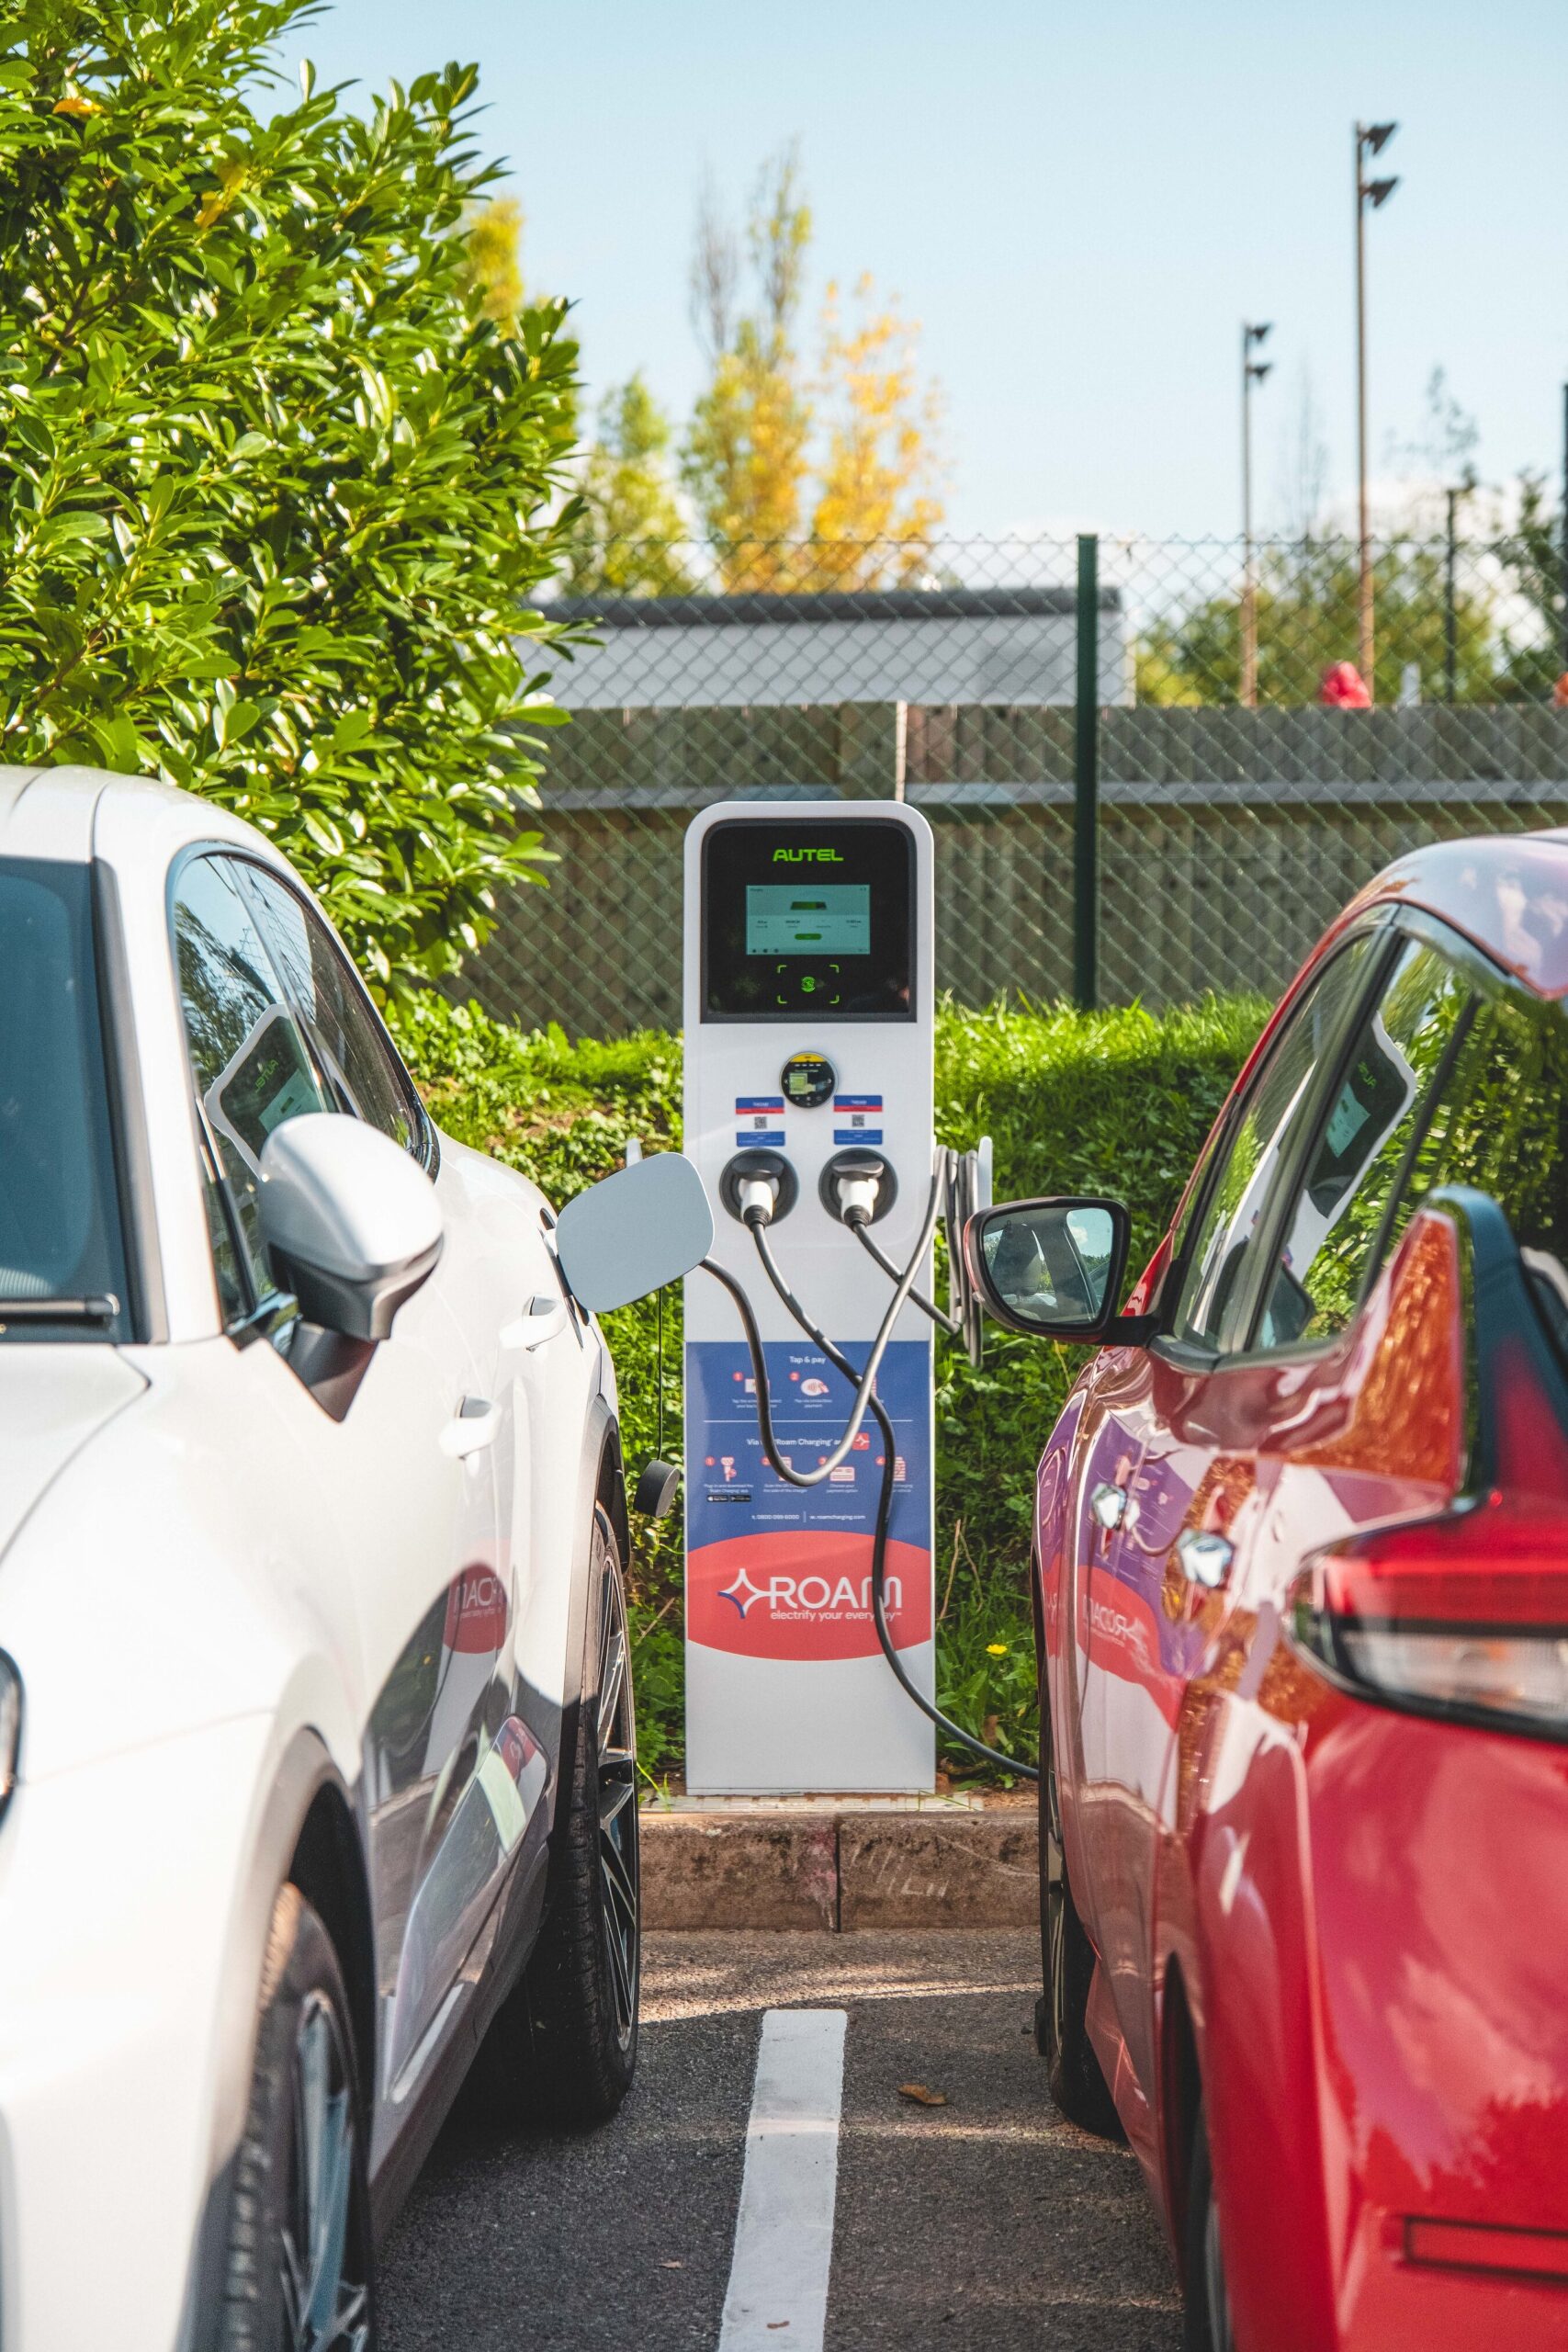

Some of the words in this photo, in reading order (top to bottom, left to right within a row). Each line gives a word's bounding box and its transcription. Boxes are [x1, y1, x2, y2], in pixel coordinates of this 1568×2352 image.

[773, 848, 844, 862] AUTEL
[789, 1355, 803, 1364] Tap
[746, 1438, 760, 1446] Via
[770, 1576, 902, 1609] ROAM
[771, 1610, 817, 1622] electrify
[818, 1611, 843, 1623] your
